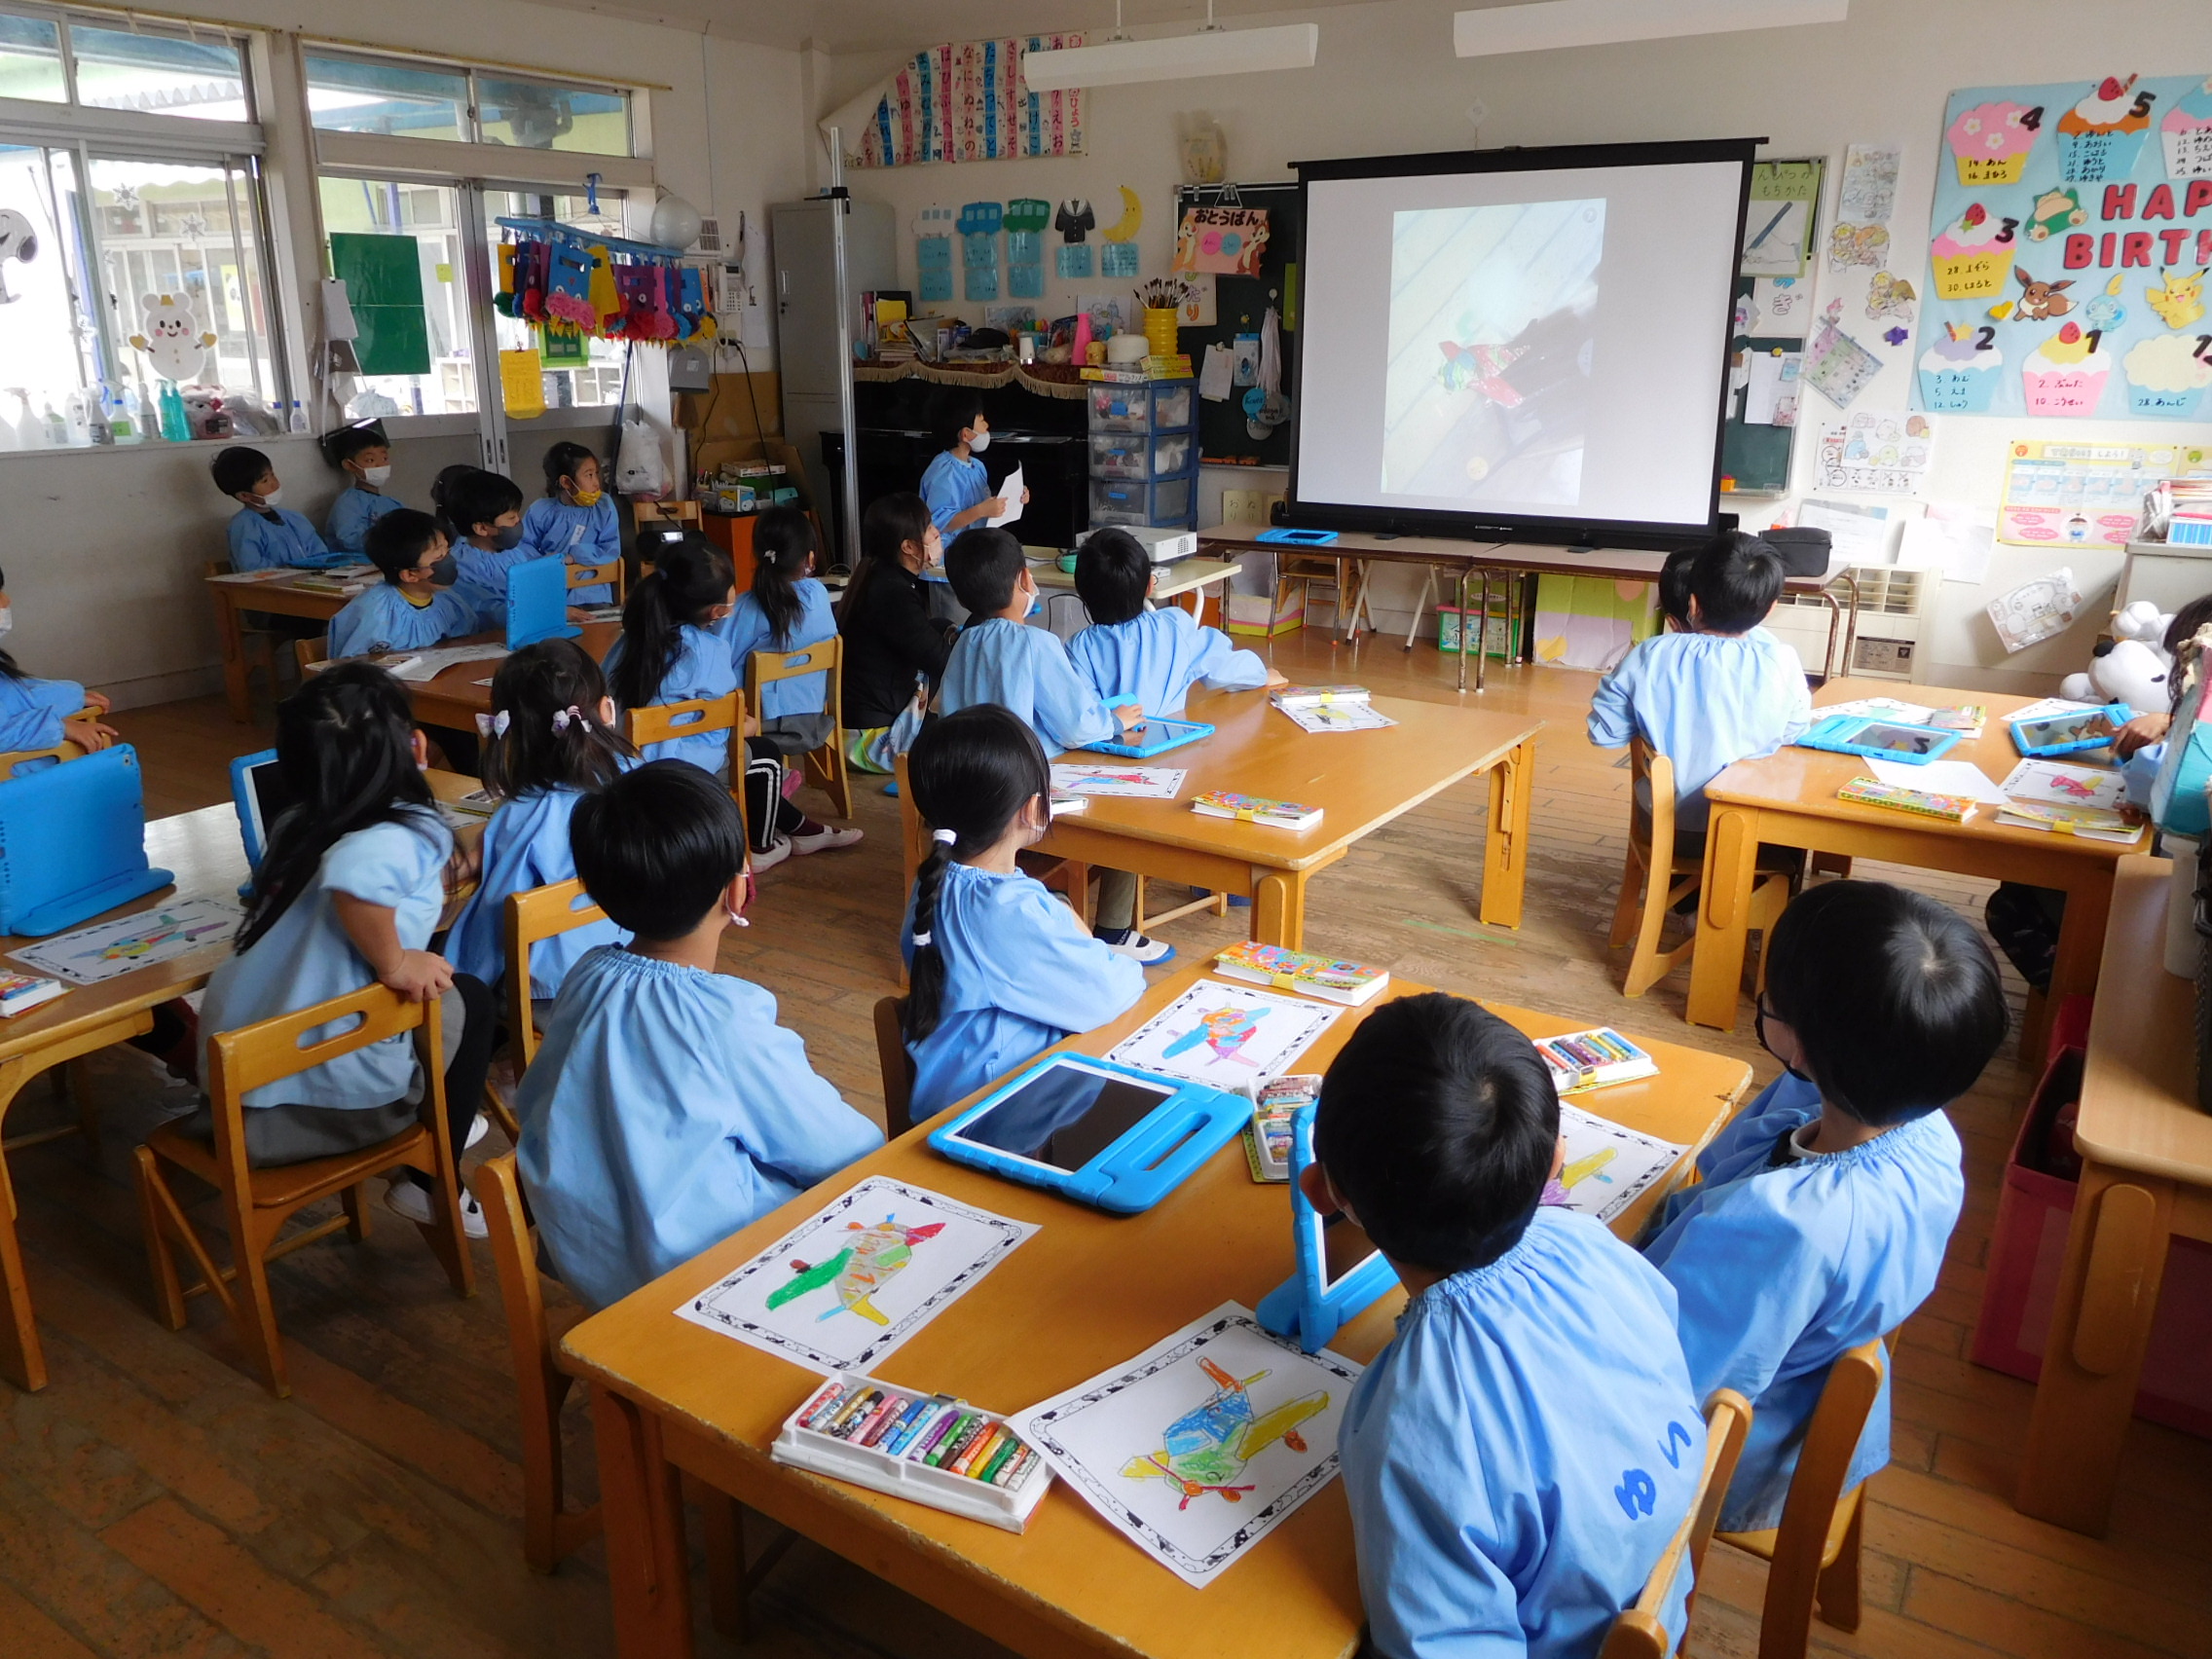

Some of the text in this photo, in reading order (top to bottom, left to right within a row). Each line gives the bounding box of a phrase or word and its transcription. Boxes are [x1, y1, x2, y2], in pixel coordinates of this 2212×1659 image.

[2128, 91, 2157, 118] 5
[2019, 105, 2045, 131] 4
[2101, 180, 2212, 220] HAP
[1194, 207, 1260, 227] おとうばん
[1994, 217, 2020, 243] 3
[1975, 326, 1996, 350] 2
[2085, 329, 2103, 353] 1
